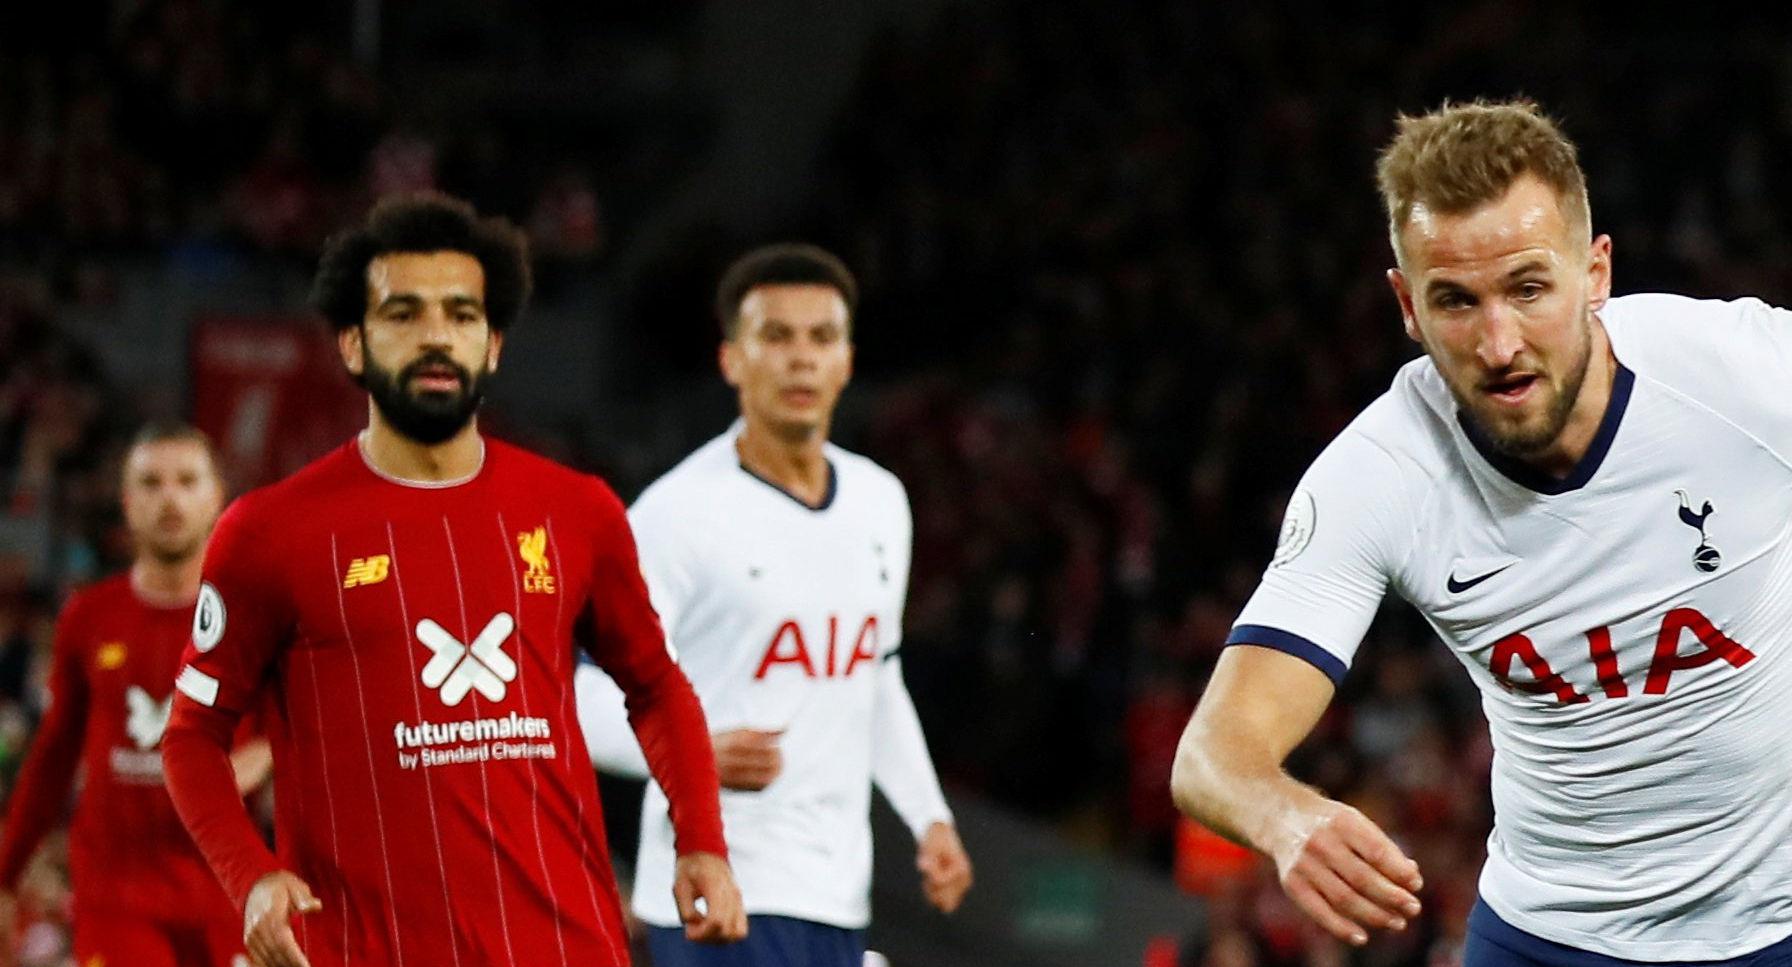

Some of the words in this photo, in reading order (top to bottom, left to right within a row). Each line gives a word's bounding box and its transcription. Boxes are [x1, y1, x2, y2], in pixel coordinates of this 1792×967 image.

[523, 574, 556, 595] LFC
[752, 615, 879, 680] AIA
[1489, 607, 1757, 704] AIA
[394, 710, 550, 749] futuremakers
[399, 750, 419, 771] by
[420, 743, 490, 768] Standard
